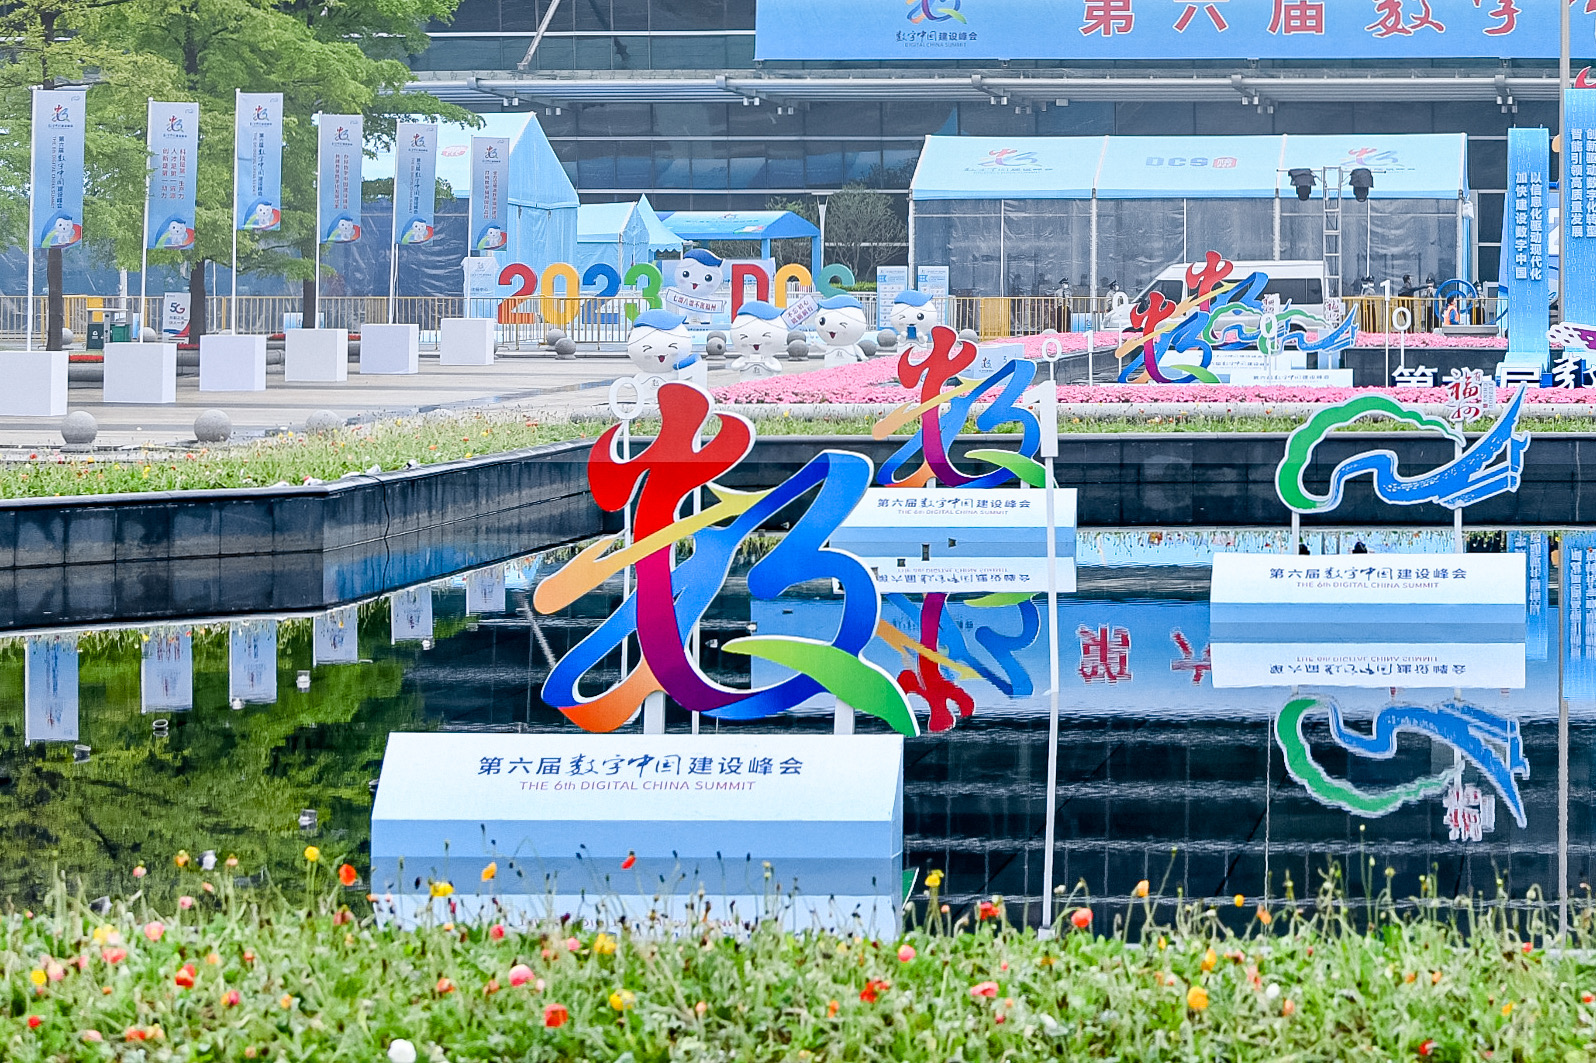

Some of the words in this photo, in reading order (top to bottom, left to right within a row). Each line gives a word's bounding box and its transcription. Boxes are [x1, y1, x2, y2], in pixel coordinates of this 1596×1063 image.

[895, 30, 978, 43] 数字中国建设峰会
[1146, 156, 1208, 167] DCS
[1570, 128, 1583, 238] 智能引领高质量发展
[1515, 171, 1527, 280] 加快建设数字中国
[1530, 171, 1542, 281] 以信息化驱动现代化
[498, 262, 663, 324] 2023
[170, 302, 186, 314] 5G
[876, 497, 1031, 509] 第六届数字中国建设峰会
[1269, 567, 1467, 581] 第六届数字中国建设峰会
[1297, 581, 1314, 589] THE
[1317, 581, 1332, 589] 6th
[1333, 581, 1368, 589] DIGITAL
[1371, 581, 1400, 589] CHINA
[1402, 581, 1439, 589] SUMMIT
[477, 754, 803, 778] 第六届数字中国建设峰会
[519, 780, 549, 791] THE
[554, 780, 576, 791] 6th
[580, 780, 638, 791] DIGITAL
[642, 780, 690, 791] CHINA
[694, 780, 756, 791] SUMMIT
